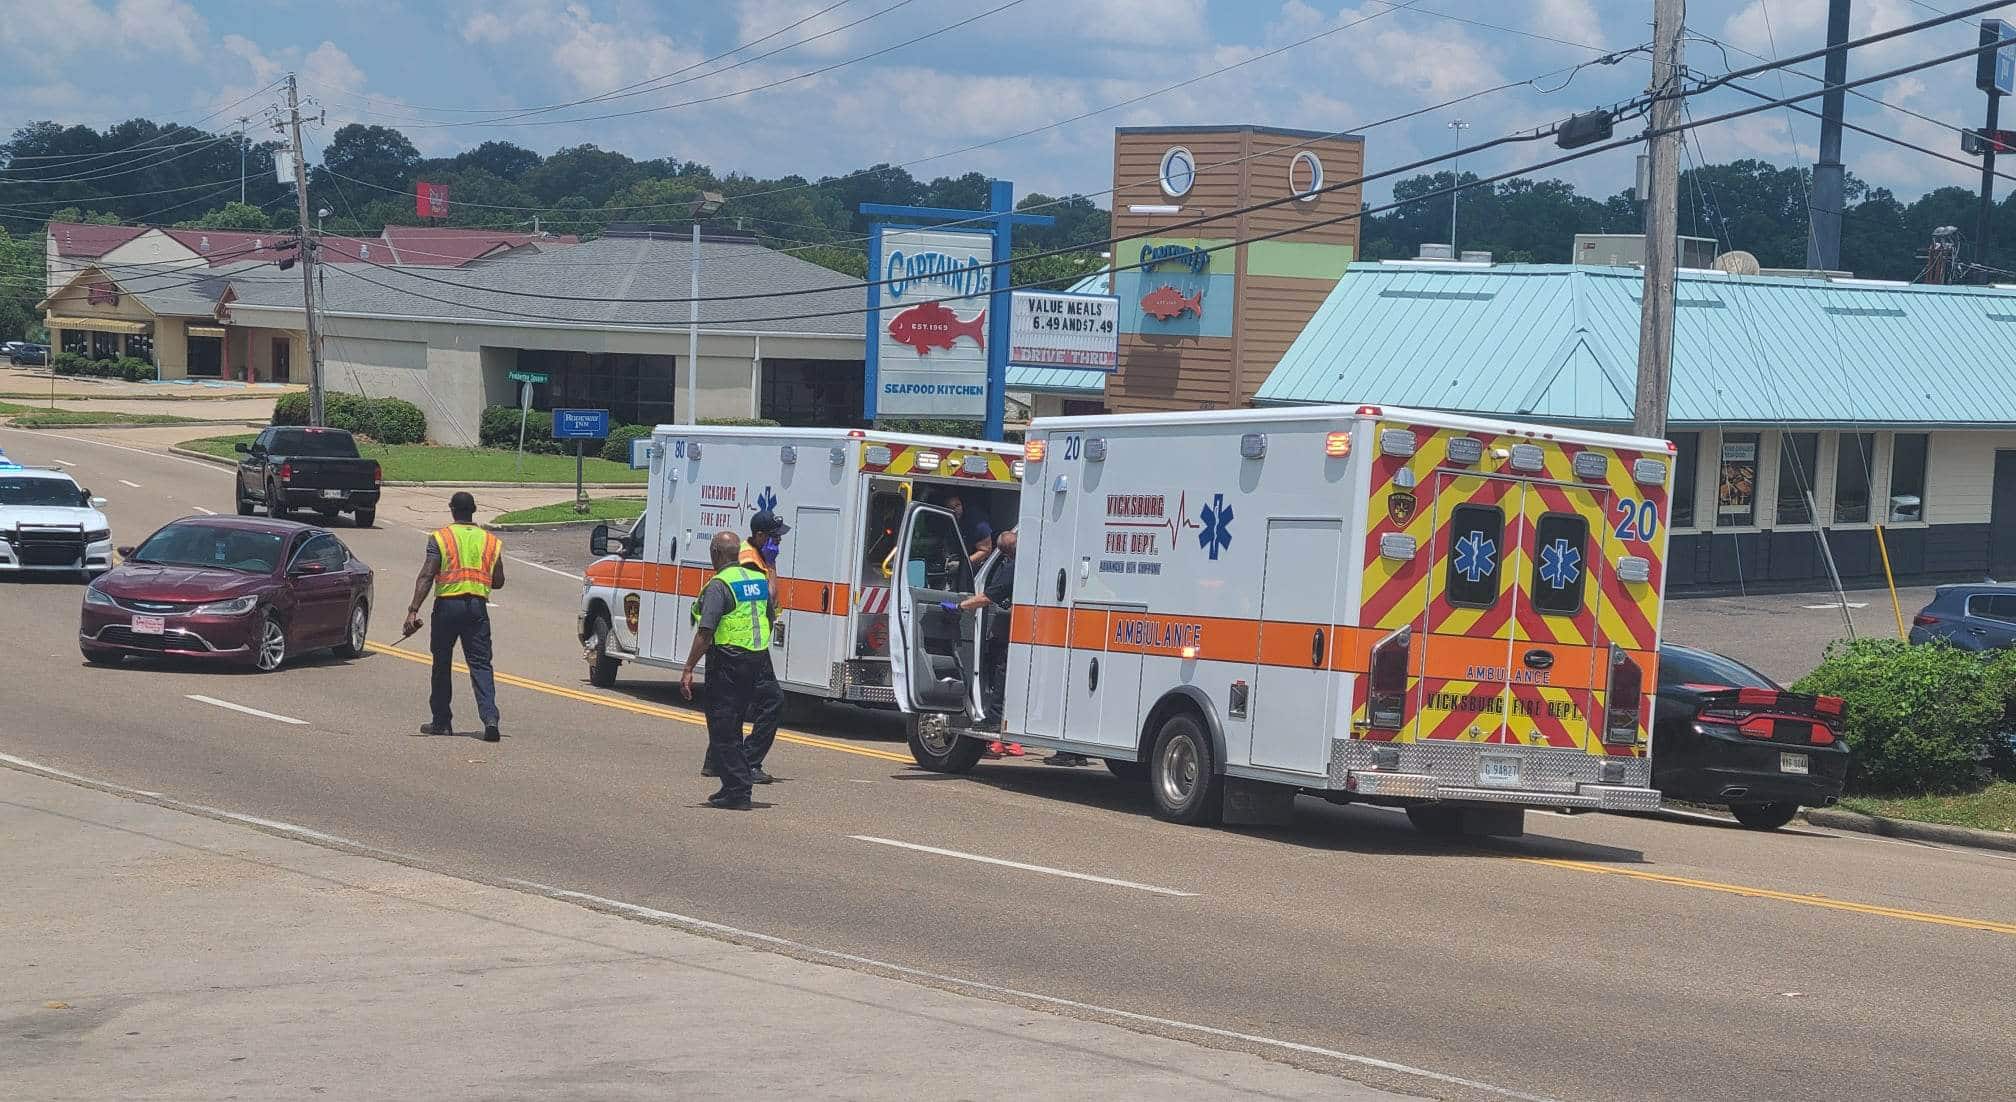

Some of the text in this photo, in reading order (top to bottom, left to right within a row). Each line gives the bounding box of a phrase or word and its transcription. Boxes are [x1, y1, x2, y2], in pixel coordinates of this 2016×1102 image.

[887, 249, 964, 299] CAPTAIN
[1028, 298, 1102, 317] VALUE MEALS
[1033, 315, 1060, 331] 6.49
[1023, 349, 1109, 365] DRIVE THRU
[884, 383, 984, 396] SEAFOOD KITCHEN
[674, 440, 686, 459] 80
[1063, 435, 1081, 461] 20
[701, 484, 736, 502] VICKSBURG
[1106, 494, 1165, 518] VICKSBURG
[700, 511, 714, 527] FIRE
[1614, 498, 1659, 542] 20
[1104, 532, 1129, 554] FIRE
[743, 583, 761, 597] EMS
[1114, 619, 1202, 648] AMBULANCE
[1466, 665, 1551, 684] AMBULANCE
[1427, 692, 1504, 715] VICKSBURG
[1512, 699, 1541, 717] FIRE
